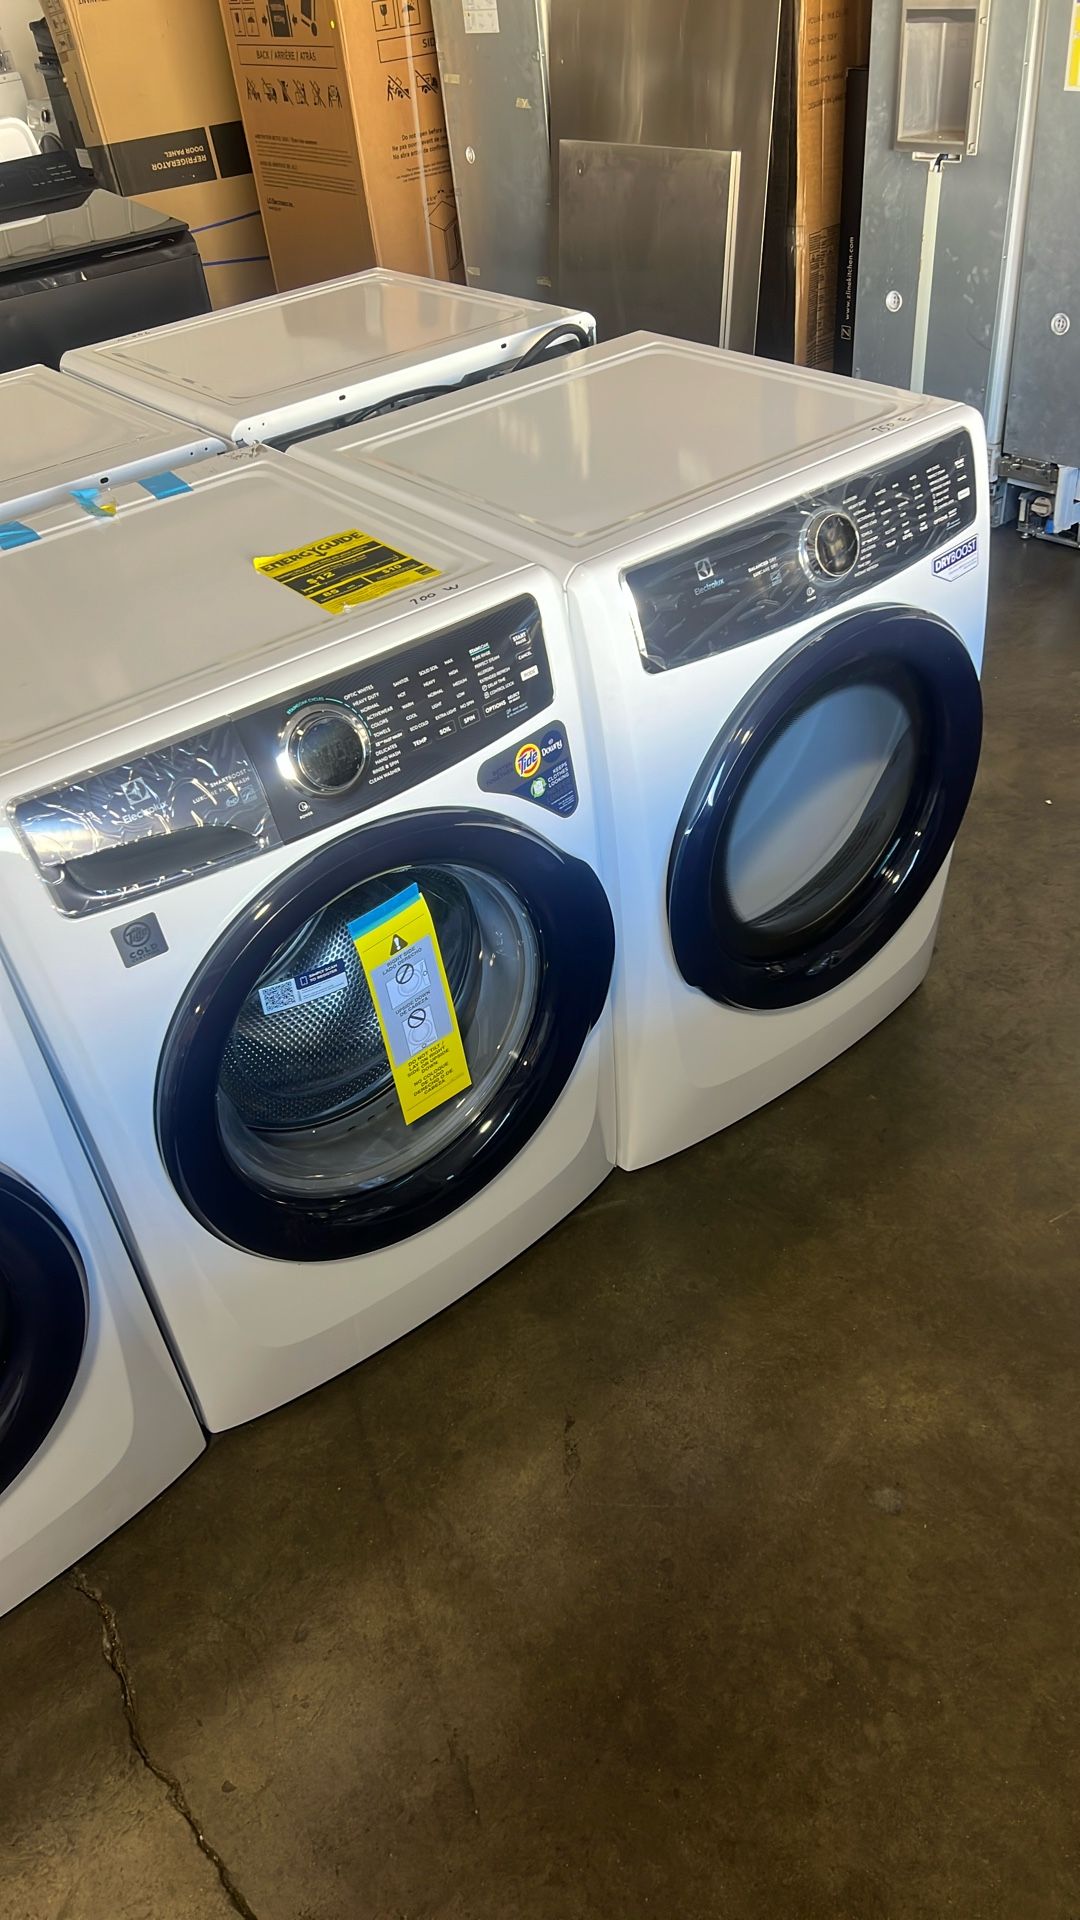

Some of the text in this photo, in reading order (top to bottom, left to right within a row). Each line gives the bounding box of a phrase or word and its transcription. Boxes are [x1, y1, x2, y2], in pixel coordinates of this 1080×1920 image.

[256, 50, 269, 60] BACK
[163, 145, 204, 158] DOOR PANEL
[151, 154, 207, 171] REFRIGERATOR
[934, 538, 976, 572] DRYBOOST
[306, 571, 335, 585] $12
[694, 577, 725, 596] Electrolux
[511, 631, 527, 642] START
[343, 684, 374, 700] OPTIC WHITES
[352, 691, 380, 707] HEAVY DUTY
[360, 702, 380, 713] NORMAL
[366, 706, 394, 720] ACTIVEWEAR
[484, 699, 507, 714] OPTIONS
[405, 712, 418, 721] COOL
[463, 713, 476, 725] SPIN
[370, 718, 389, 729] COLORS
[373, 727, 391, 738] TOWELS
[439, 725, 452, 736] SOIL
[412, 736, 428, 747] TEMP
[375, 743, 398, 757] DELICATES
[375, 750, 402, 765] HAND WASH
[517, 748, 539, 775] Tide
[541, 739, 563, 758] Downy
[552, 761, 568, 774] KEEPS
[368, 766, 401, 785] CLEAN WASHER
[547, 766, 569, 783] CLOTHES
[548, 772, 570, 788] LOOKING
[122, 801, 168, 824] Elecolux
[130, 943, 158, 959] COLD
[386, 954, 402, 967] RIGHT
[382, 964, 397, 976] LADO
[417, 1050, 429, 1060] NOT
[408, 1063, 419, 1071] LAY
[421, 1061, 438, 1073] DOWN
[423, 1061, 449, 1080] COLOQUE
[429, 1069, 445, 1081] LADO
